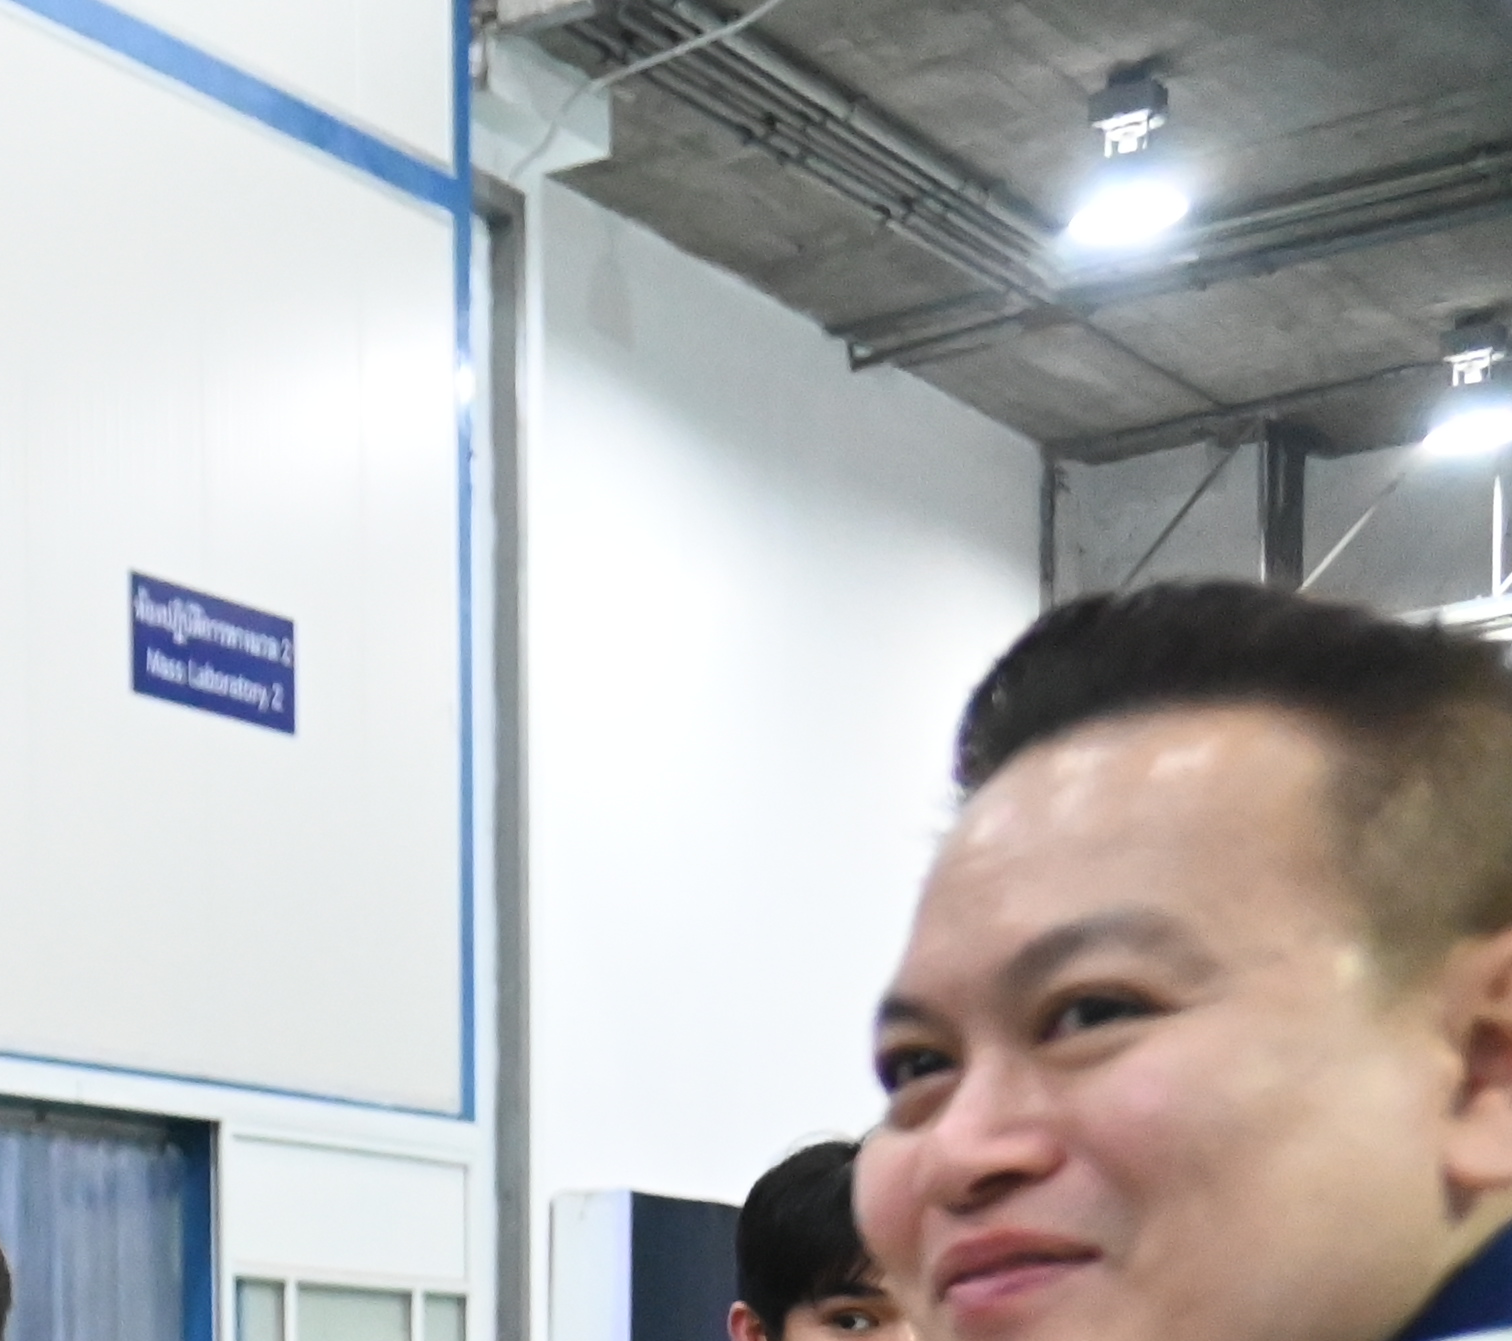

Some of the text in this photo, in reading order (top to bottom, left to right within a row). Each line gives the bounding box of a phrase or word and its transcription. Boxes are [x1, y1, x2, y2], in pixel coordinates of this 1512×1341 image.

[281, 637, 292, 668] 2
[146, 646, 284, 712] Mass Laboratory 2
